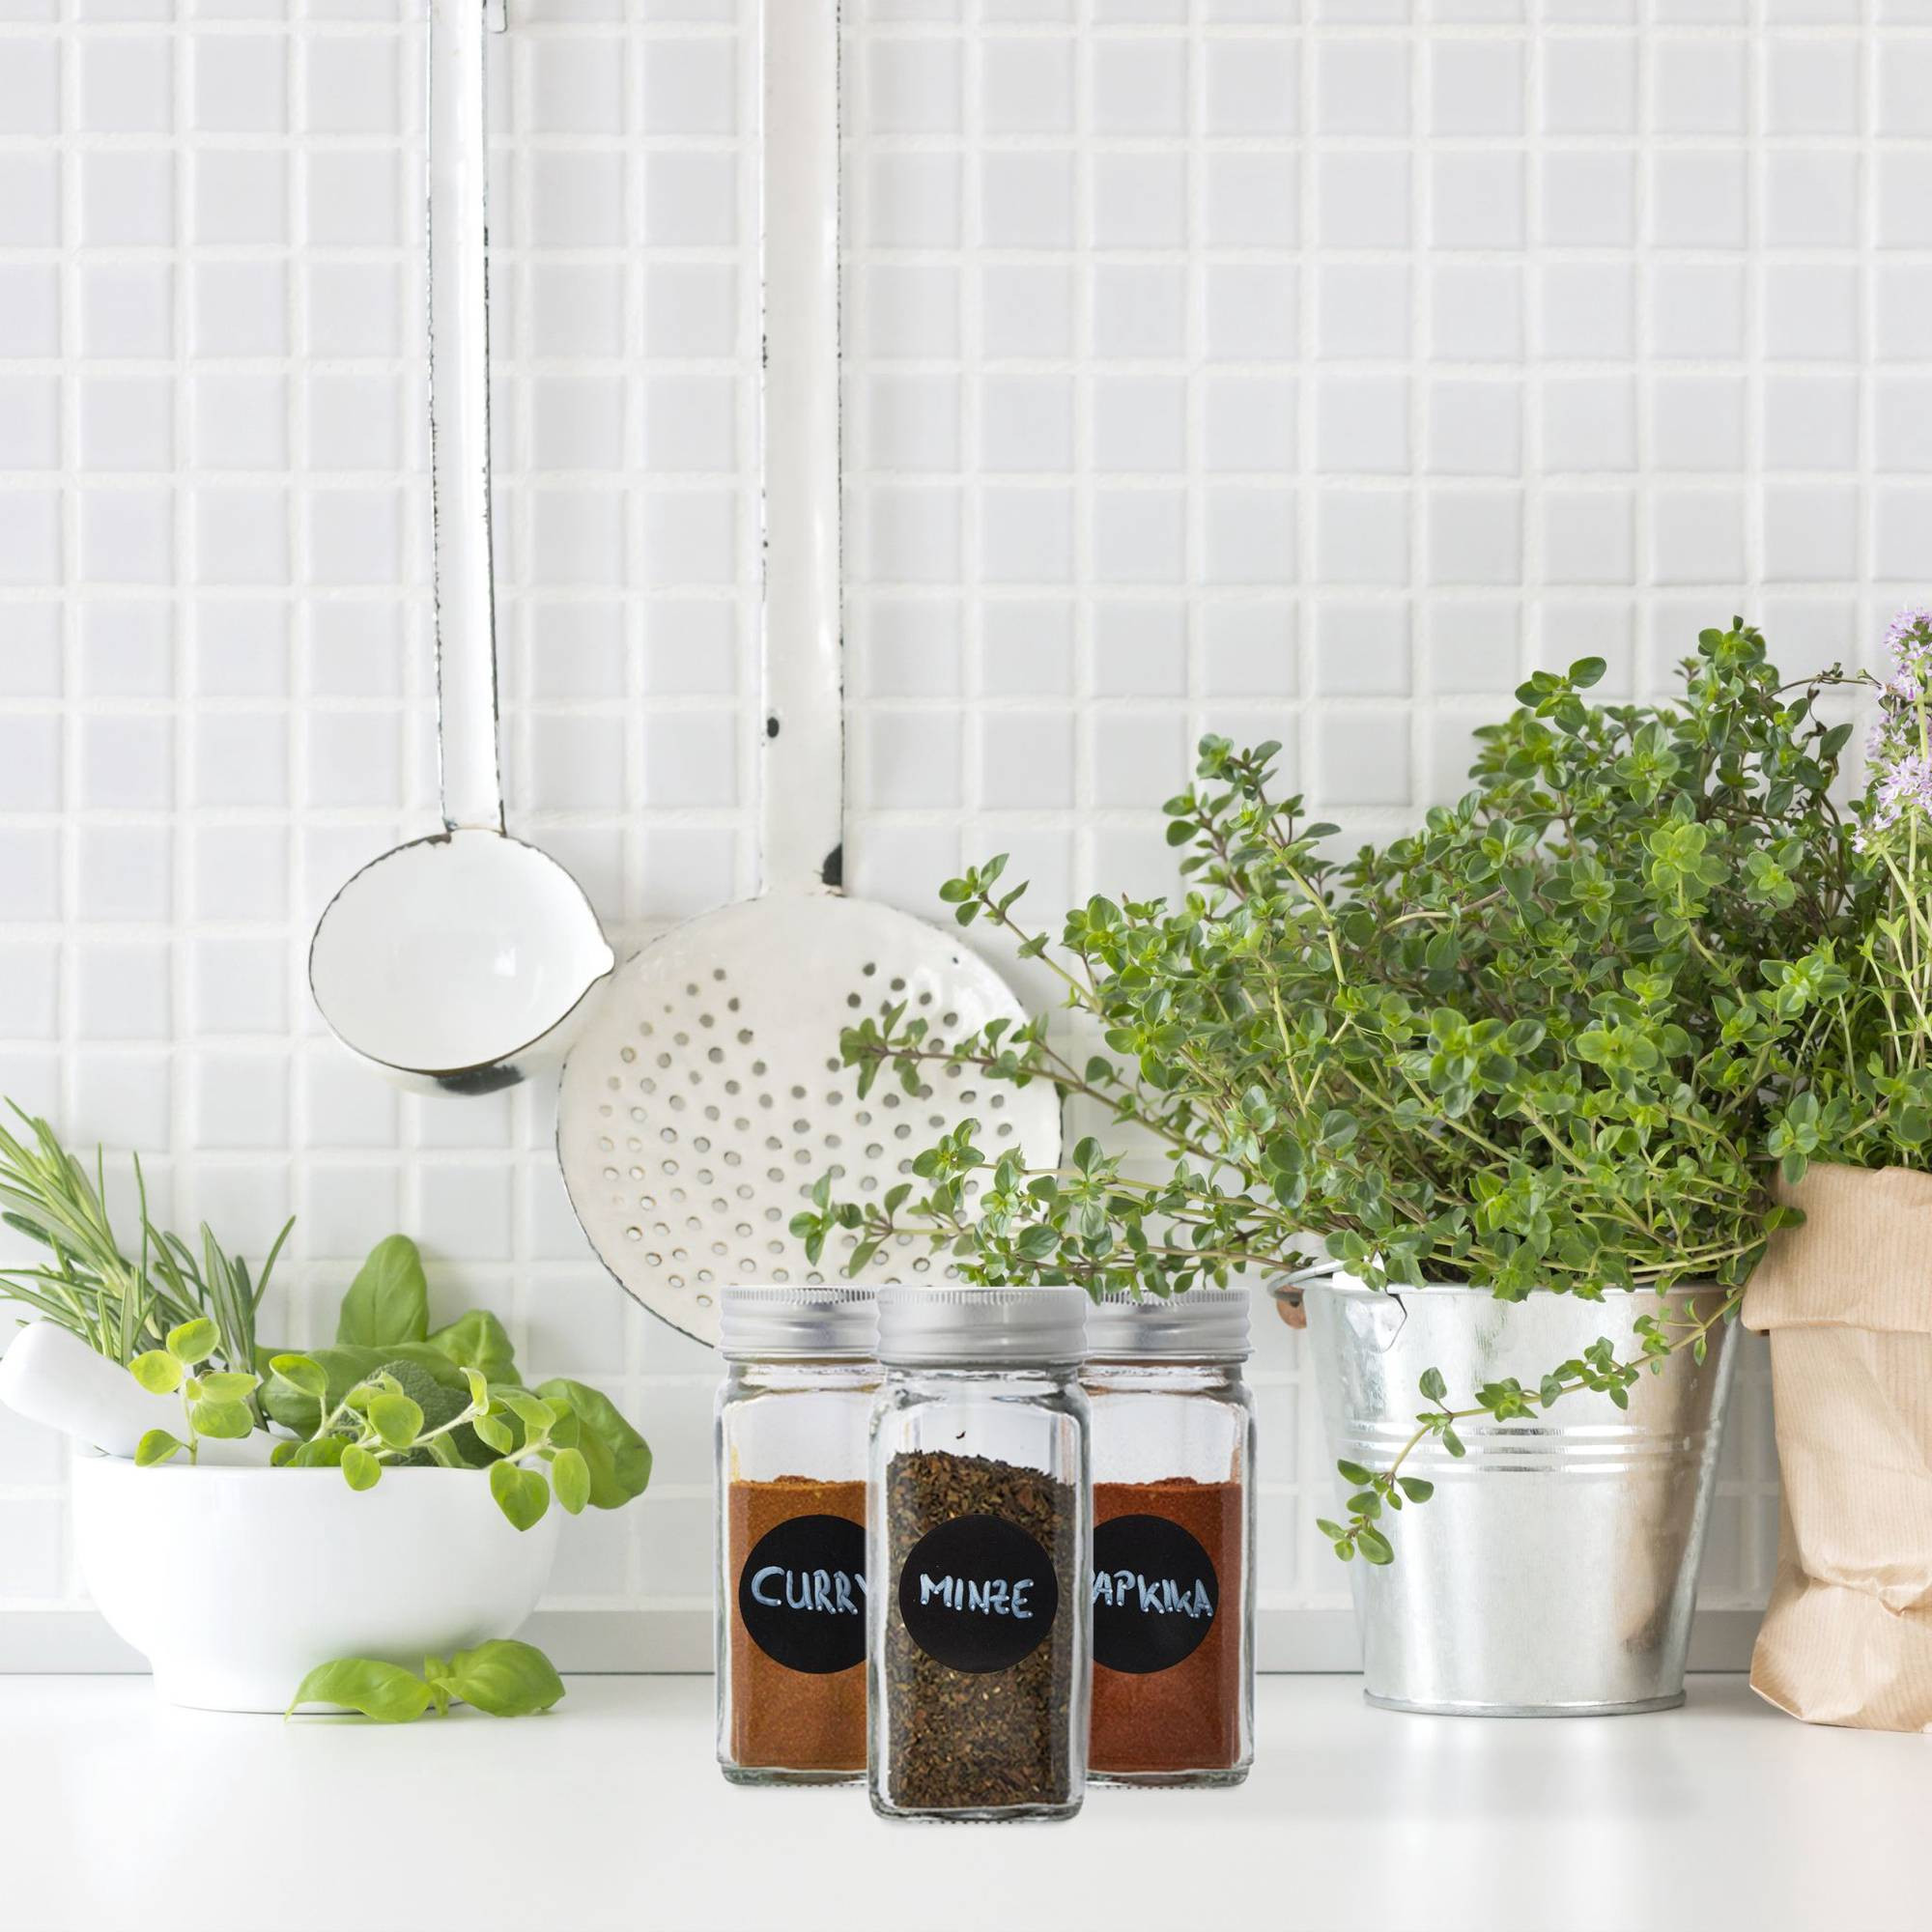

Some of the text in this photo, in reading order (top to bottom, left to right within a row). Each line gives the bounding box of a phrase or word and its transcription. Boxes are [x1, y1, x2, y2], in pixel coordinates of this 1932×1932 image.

[751, 1565, 867, 1615] CURR
[920, 1573, 1035, 1619] MINZE
[1092, 1570, 1213, 1618] APKIKA
